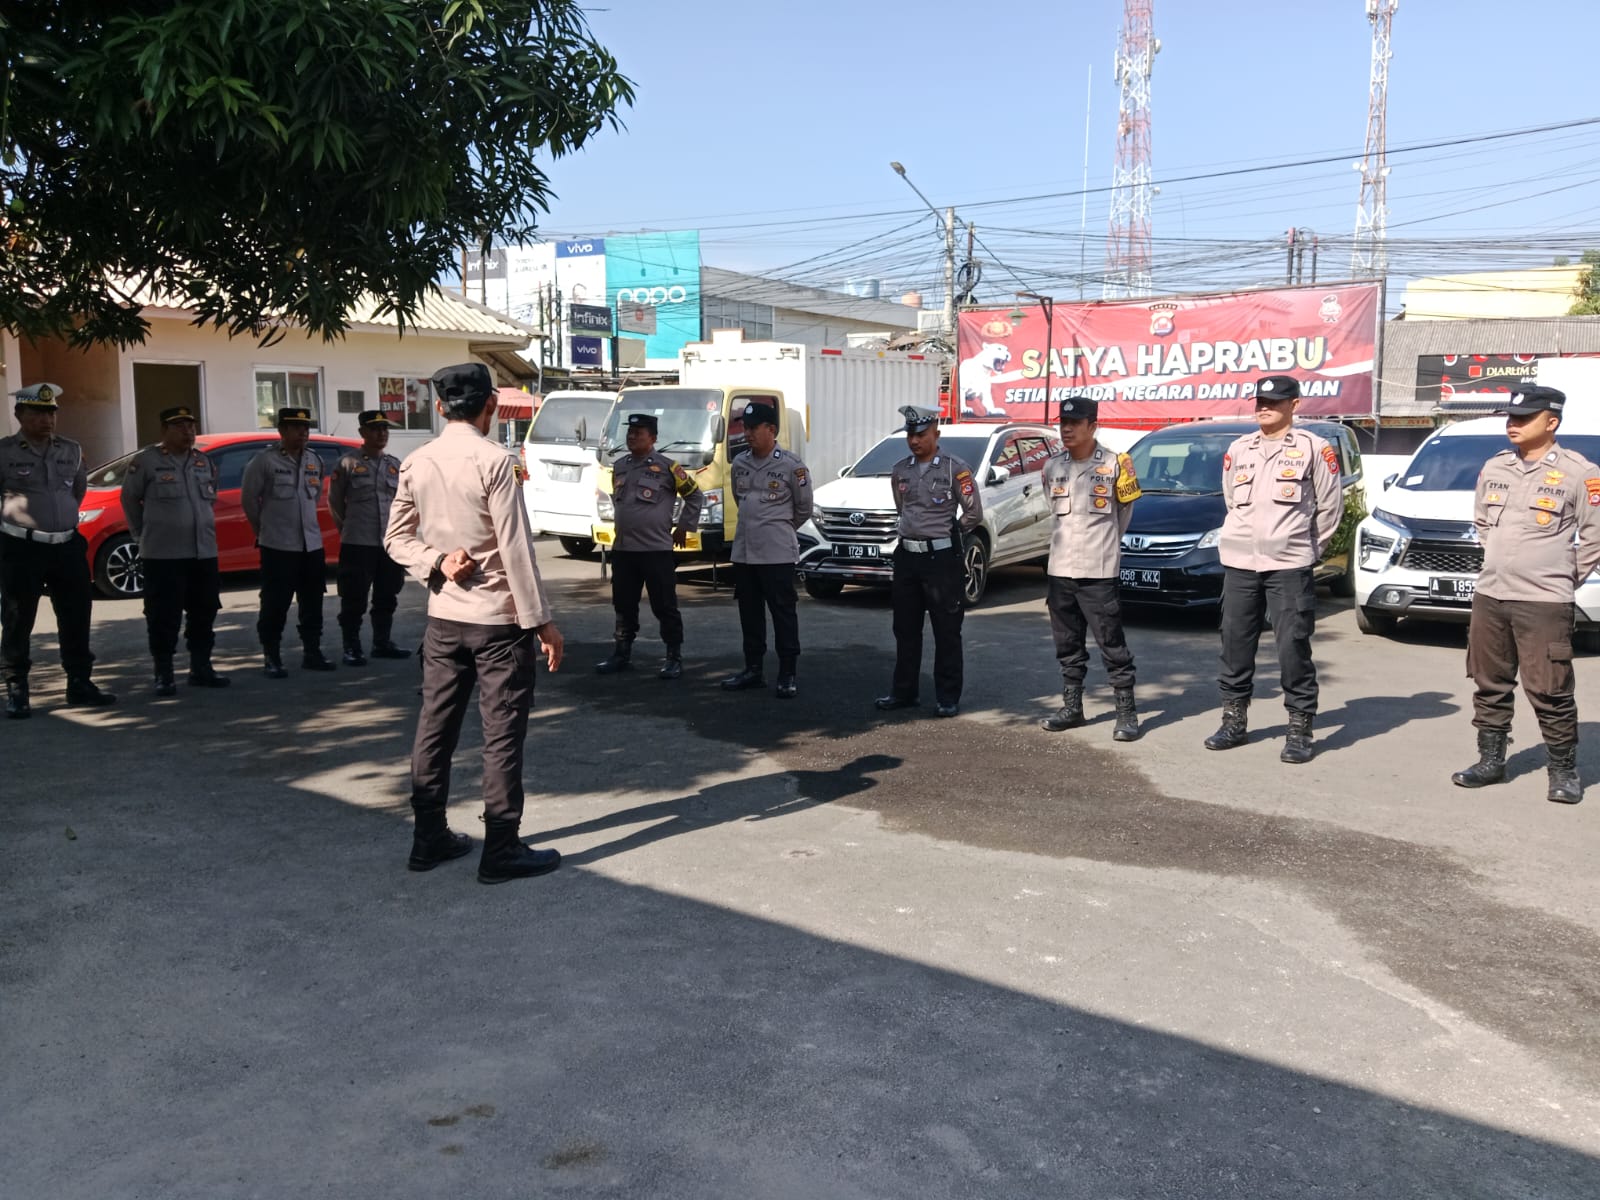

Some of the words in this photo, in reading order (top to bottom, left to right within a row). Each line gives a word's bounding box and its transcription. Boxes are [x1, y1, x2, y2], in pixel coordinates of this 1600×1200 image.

[567, 243, 593, 254] vivo
[617, 285, 687, 307] oppo
[574, 311, 609, 326] Infinix
[576, 345, 598, 354] vivo
[1022, 345, 1127, 379] SATYA
[1137, 336, 1325, 376] HAPRABU
[1005, 387, 1047, 403] SETIA
[1122, 383, 1194, 401] NEGARA
[1197, 383, 1238, 400] DAN
[1278, 459, 1304, 467] POLRI
[1537, 486, 1566, 497] POLRI
[848, 546, 863, 556] 1729
[1431, 578, 1439, 591] A
